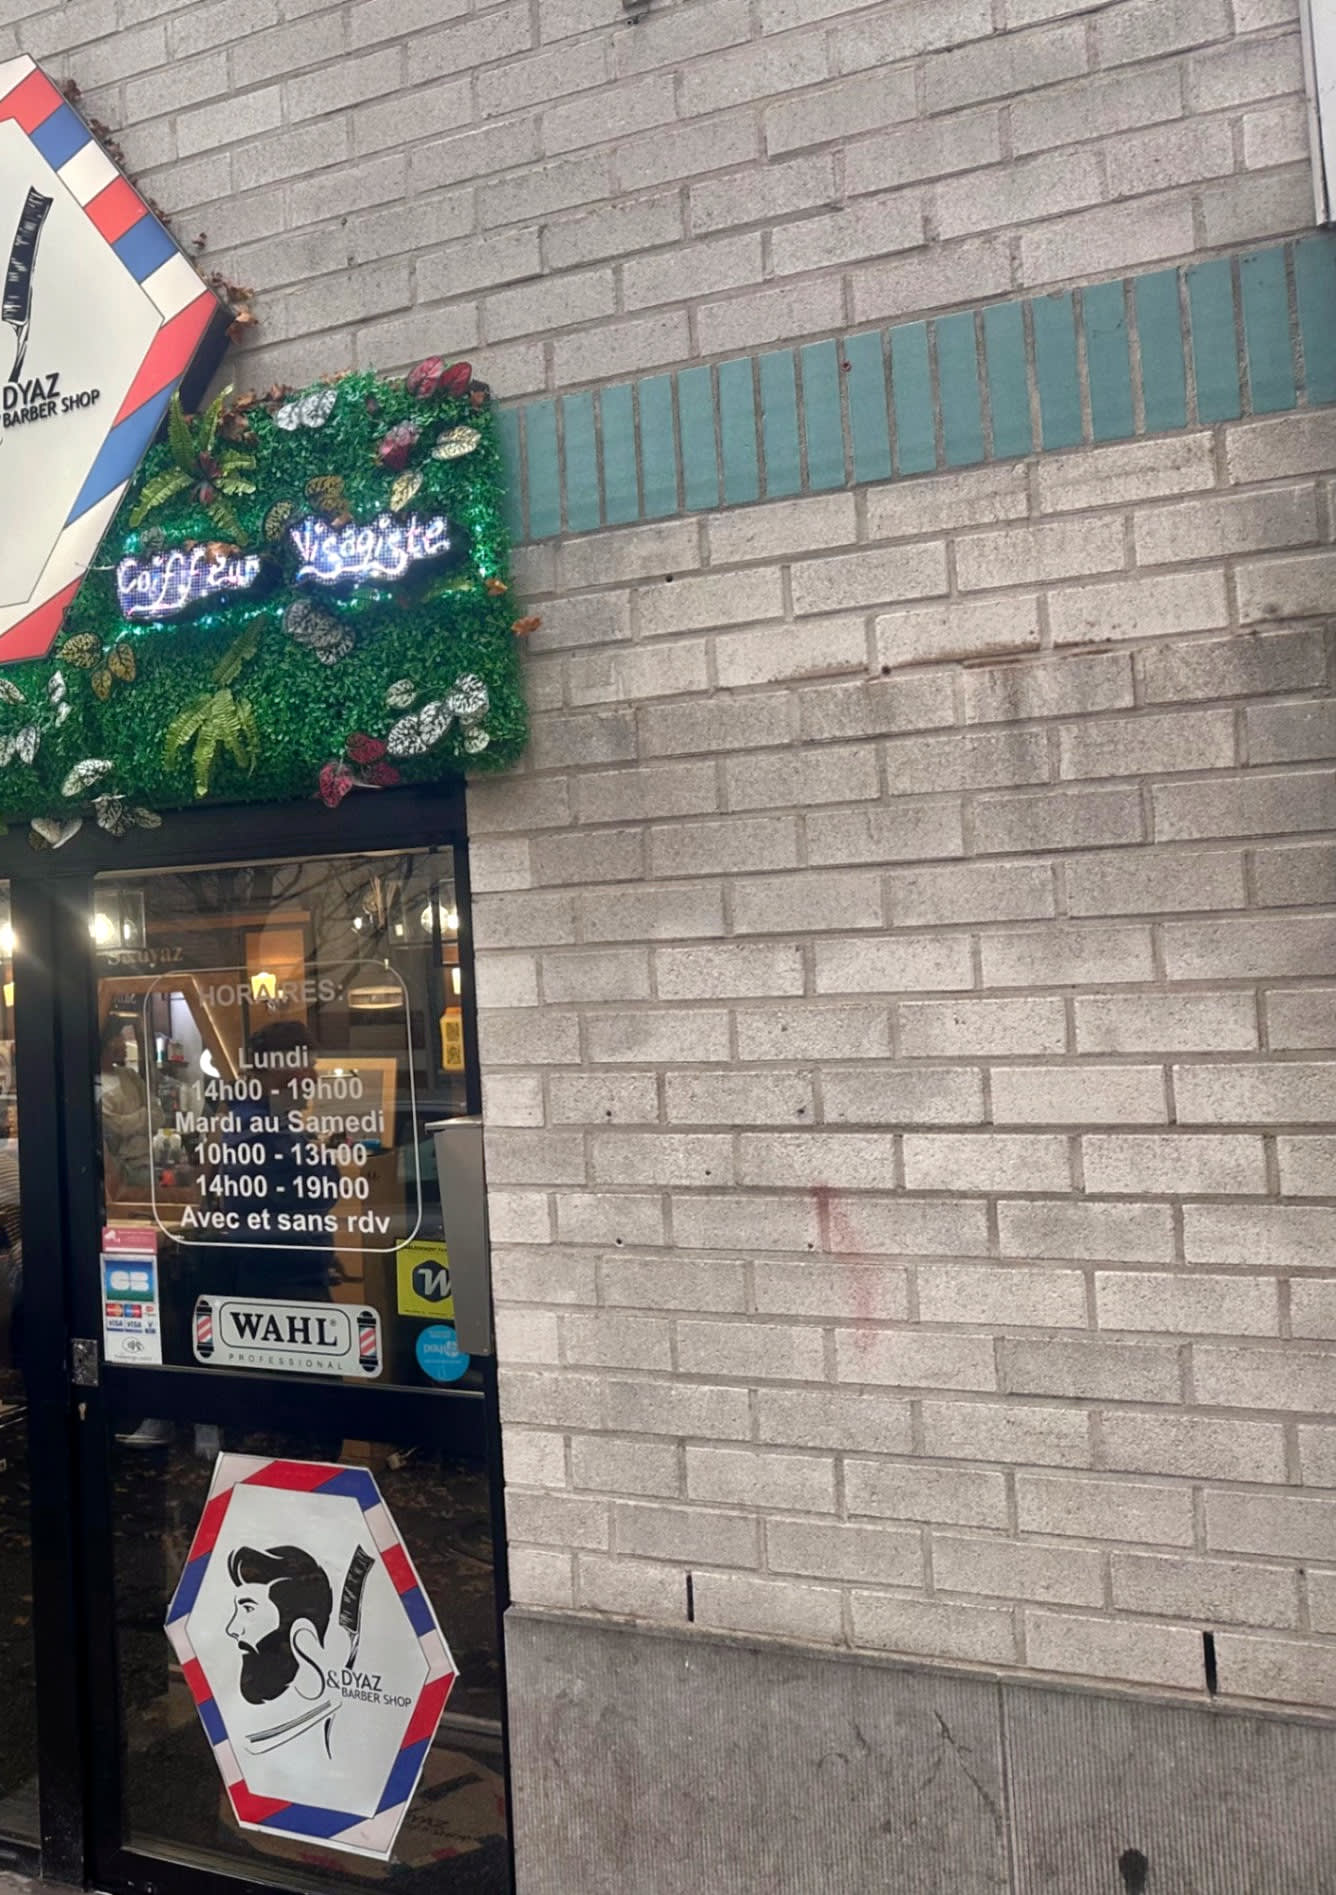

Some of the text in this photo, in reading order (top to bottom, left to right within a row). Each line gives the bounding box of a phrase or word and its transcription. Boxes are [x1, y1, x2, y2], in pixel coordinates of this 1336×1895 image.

[3, 389, 100, 428] BARBER SHOP
[290, 513, 451, 580] Visagiste
[239, 1045, 309, 1069] Lundi
[192, 1078, 262, 1101] 14h00
[287, 1077, 364, 1101] 19h00
[175, 1110, 385, 1133] Mardi au Samedi
[194, 1142, 265, 1166] 10h00
[290, 1143, 367, 1166] 13h00
[196, 1175, 267, 1198] 14h00
[292, 1176, 370, 1199] 19h00
[180, 1205, 391, 1234] Avec et sans rdv
[229, 1311, 338, 1347] WAHL
[228, 1352, 344, 1371] PROFESSIONAL
[341, 1687, 412, 1708] BARBER SHOP
